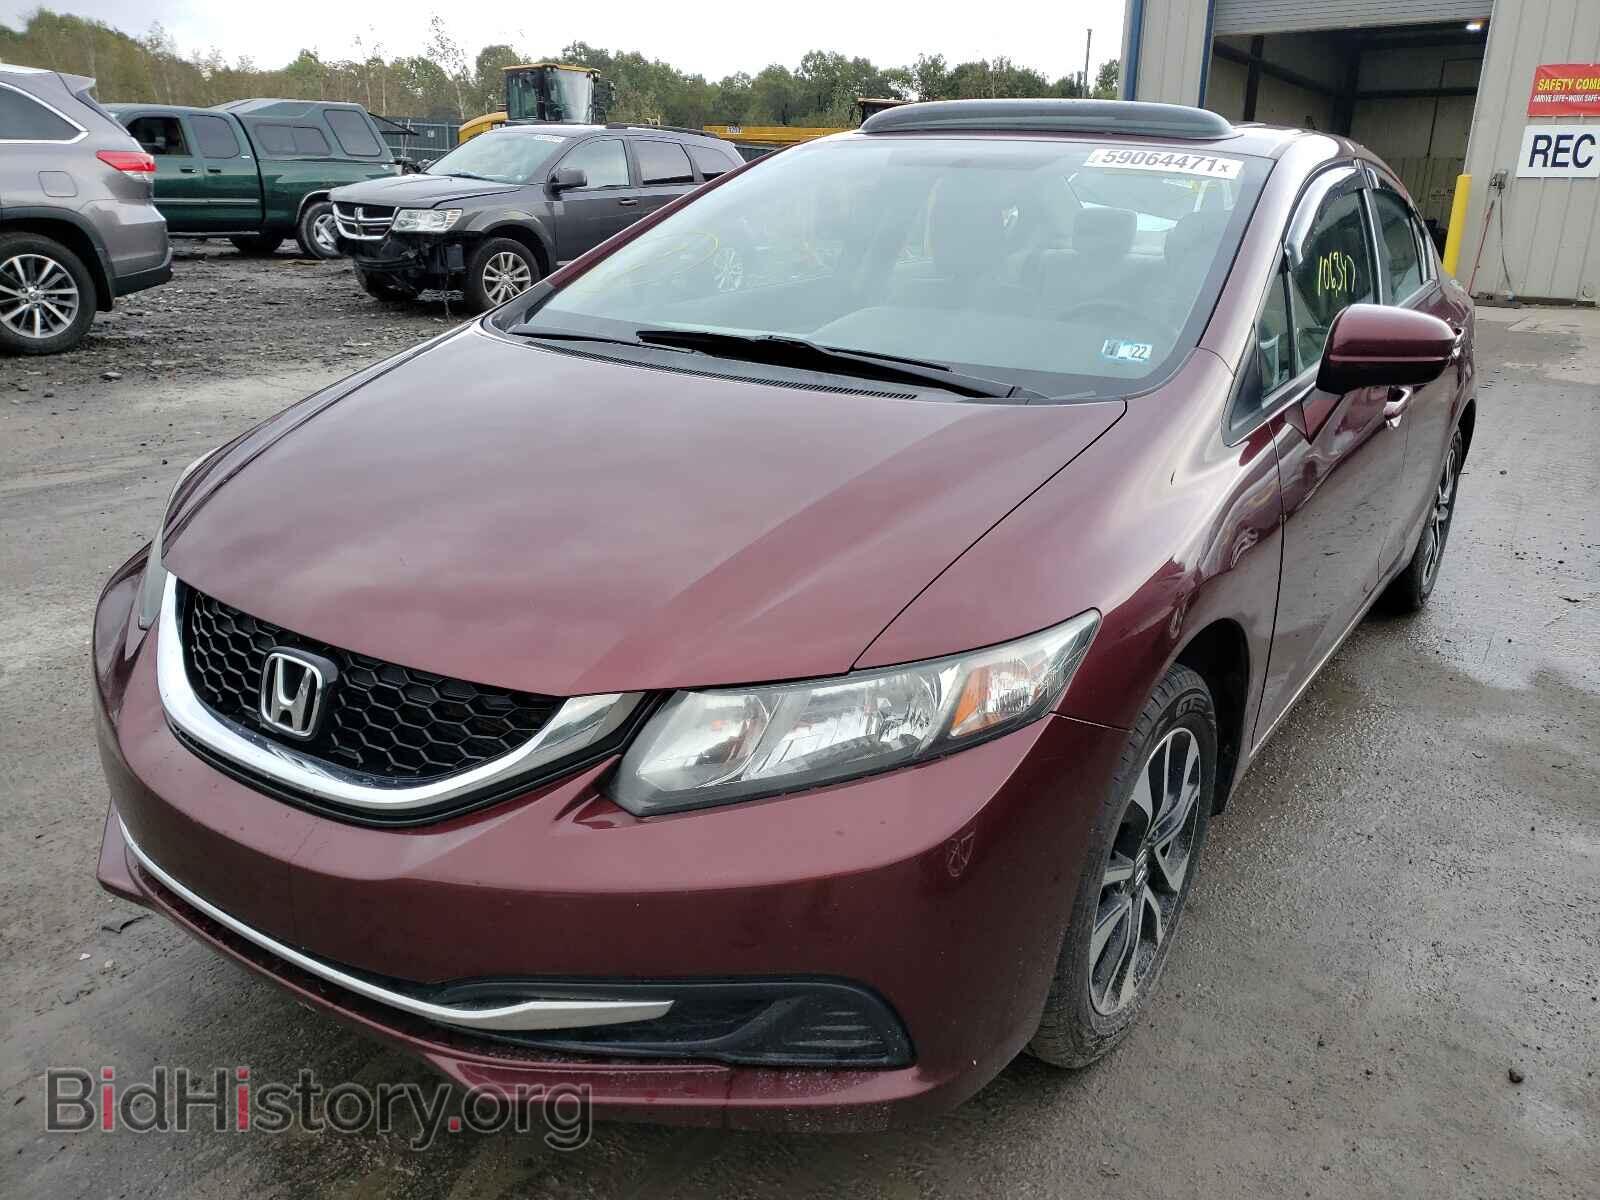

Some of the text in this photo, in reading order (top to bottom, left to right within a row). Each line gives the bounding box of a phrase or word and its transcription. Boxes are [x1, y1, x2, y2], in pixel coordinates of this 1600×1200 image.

[1538, 78, 1574, 91] SAFETY
[1528, 133, 1596, 169] REC
[1131, 344, 1148, 360] 22
